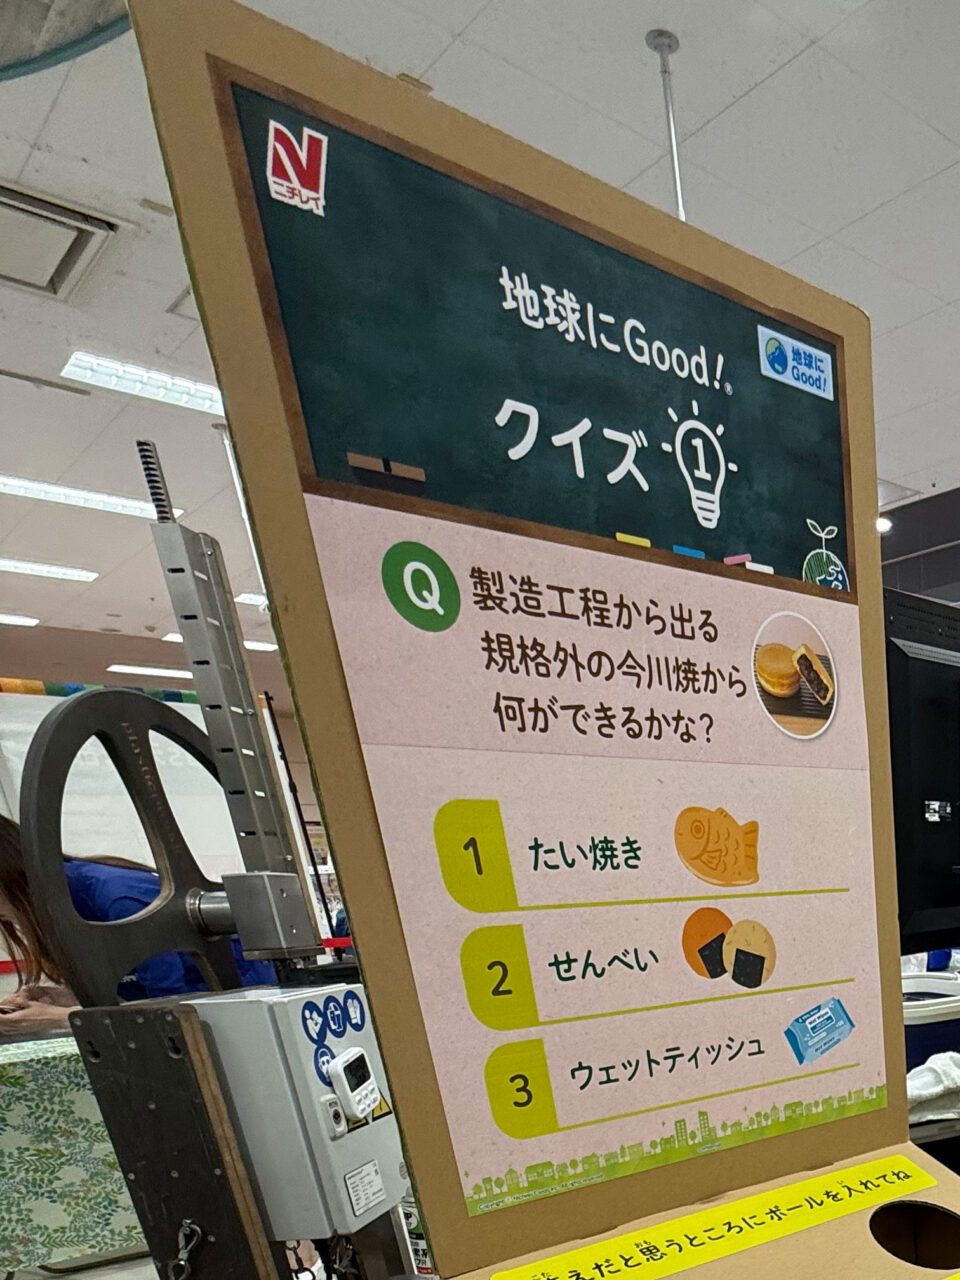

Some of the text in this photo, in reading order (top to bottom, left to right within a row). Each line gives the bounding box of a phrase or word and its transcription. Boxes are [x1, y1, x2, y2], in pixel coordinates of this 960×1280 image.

[272, 180, 320, 210] ニチレイ
[791, 345, 824, 373] 地球に
[791, 365, 826, 392] Good!
[495, 398, 650, 492] クイズ
[691, 437, 711, 482] 1
[403, 560, 444, 615] Q
[469, 566, 718, 642] 製造工程から出る
[482, 631, 747, 697] 規格外の今川焼から
[493, 694, 713, 743] 何ができるかな?
[463, 837, 482, 876] 1
[528, 836, 642, 872] たい焼き
[488, 960, 512, 996] 2
[548, 949, 659, 982] せんべい
[570, 1036, 765, 1091] ウェットティッシュ
[510, 1075, 533, 1107] 3
